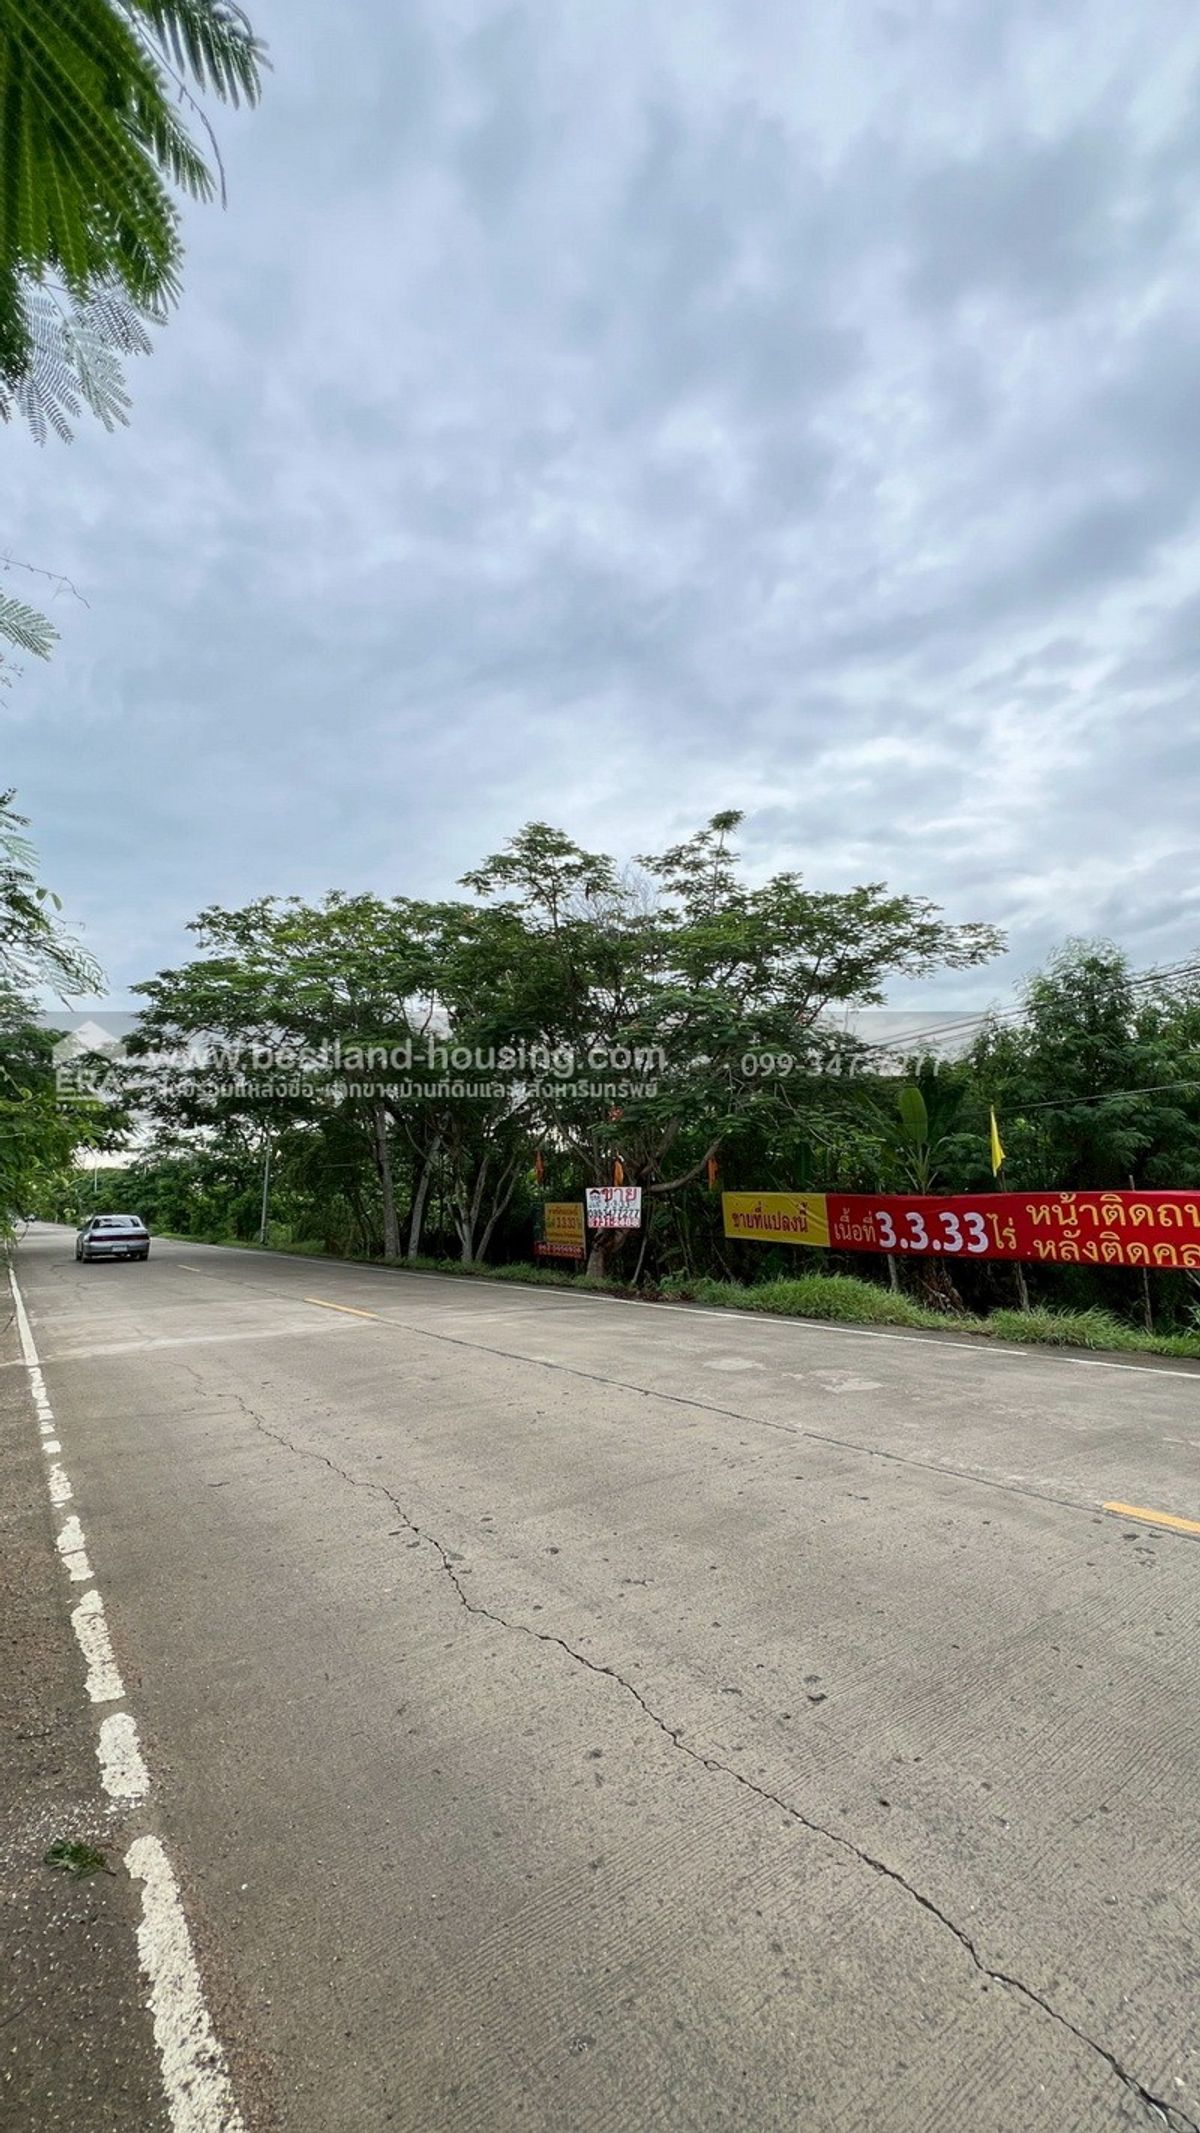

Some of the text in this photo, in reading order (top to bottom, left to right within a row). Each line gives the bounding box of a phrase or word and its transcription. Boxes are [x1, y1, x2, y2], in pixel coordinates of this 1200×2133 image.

[601, 1188, 637, 1202] ขาย
[731, 1201, 809, 1233] ขายที่แปลงนี้
